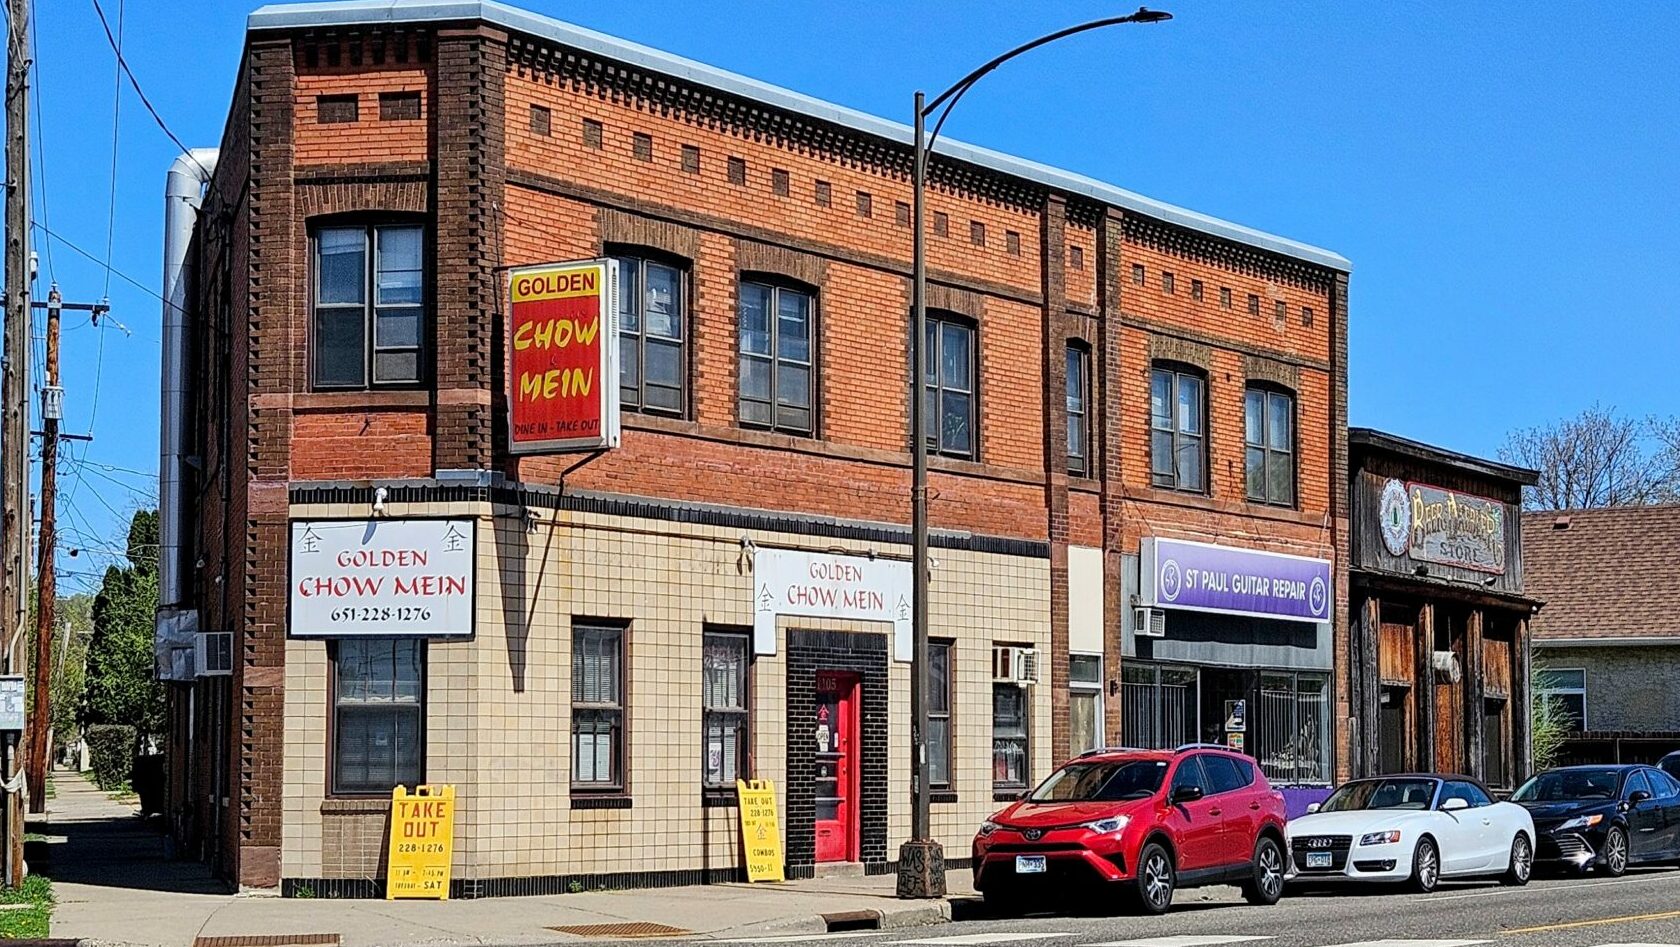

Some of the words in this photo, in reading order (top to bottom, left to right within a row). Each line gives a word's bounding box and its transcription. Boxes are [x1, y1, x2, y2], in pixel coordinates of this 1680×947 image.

[518, 272, 595, 297] GOLDEN
[513, 315, 599, 351] CHOW
[519, 367, 594, 403] MEIN
[515, 422, 535, 435] DINE
[538, 422, 548, 434] IN
[556, 420, 579, 432] TAKE
[582, 418, 599, 431] OUT
[298, 524, 324, 554] 金
[441, 524, 468, 554] 金
[337, 549, 428, 568] GOLDEN
[1440, 541, 1480, 563] STORE
[809, 562, 863, 583] GOLDEN
[299, 575, 385, 597] CHOW
[394, 575, 466, 597] MEIN
[1185, 568, 1200, 589] ST
[1202, 569, 1229, 593] PAUL
[1232, 574, 1270, 597] GUITAR
[1273, 579, 1306, 601] REPAIR
[758, 582, 774, 612] 金
[787, 584, 838, 607] CHOW
[843, 589, 884, 611] MEIN
[896, 594, 911, 621] 金
[331, 607, 431, 623] 651-228-1276
[817, 678, 837, 690] 1105
[399, 802, 446, 819] TAKE
[744, 797, 758, 805] TAKE
[761, 797, 773, 805] OUT
[404, 822, 439, 837] OUT
[399, 844, 443, 853] 228-1276
[753, 848, 775, 857] COMBOS
[424, 881, 442, 889] SAT
